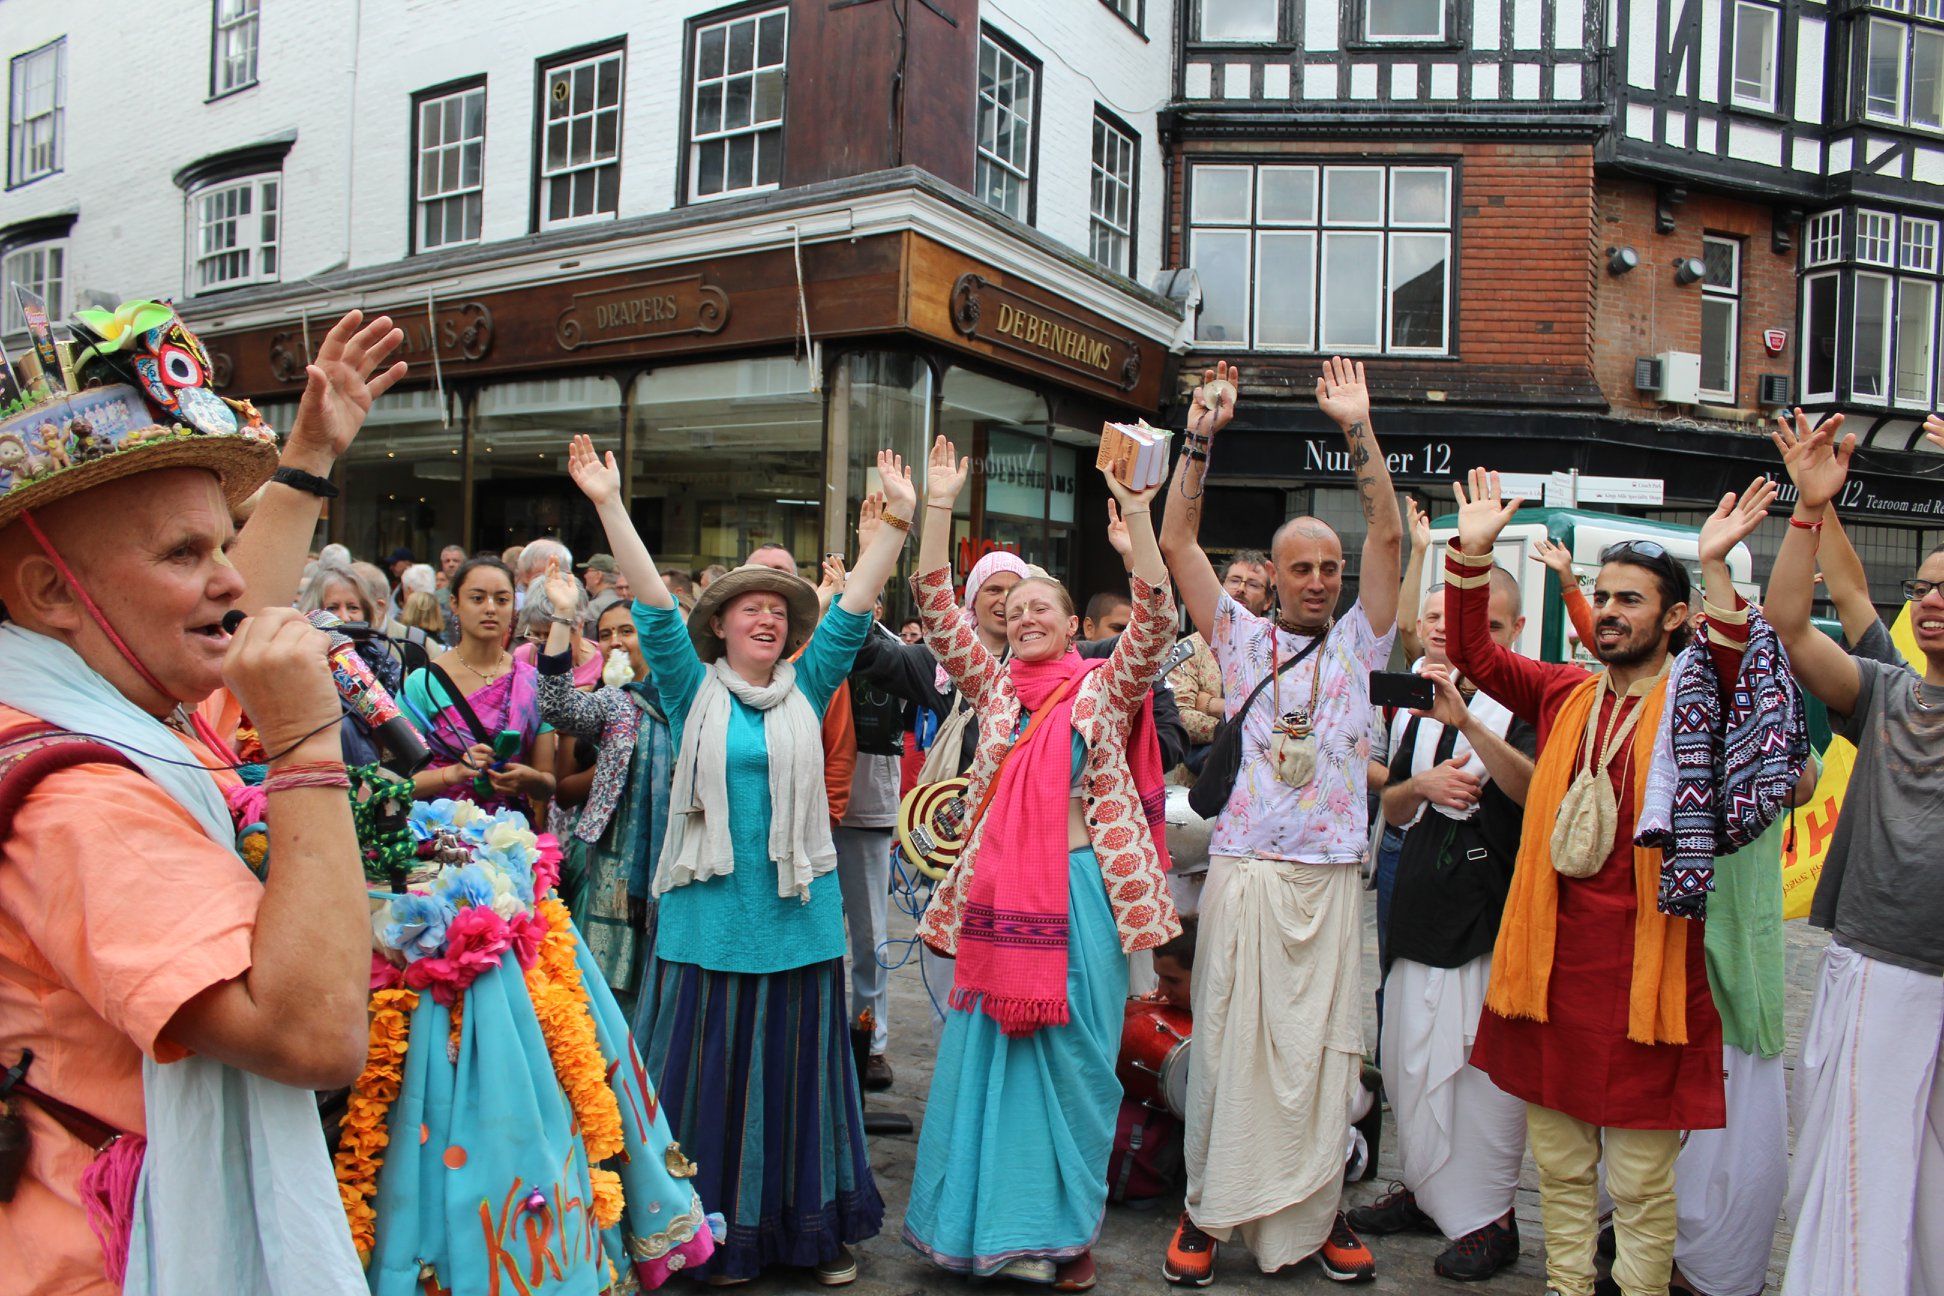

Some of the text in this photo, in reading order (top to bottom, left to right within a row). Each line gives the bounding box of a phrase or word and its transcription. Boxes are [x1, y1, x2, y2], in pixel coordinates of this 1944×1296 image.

[596, 295, 677, 329] DRAPERS
[996, 303, 1112, 371] DEBENHAMS
[1304, 440, 1451, 474] Nuer 12
[1839, 480, 1864, 508] 12
[1866, 494, 1909, 512] Tearoom
[1911, 499, 1932, 513] and
